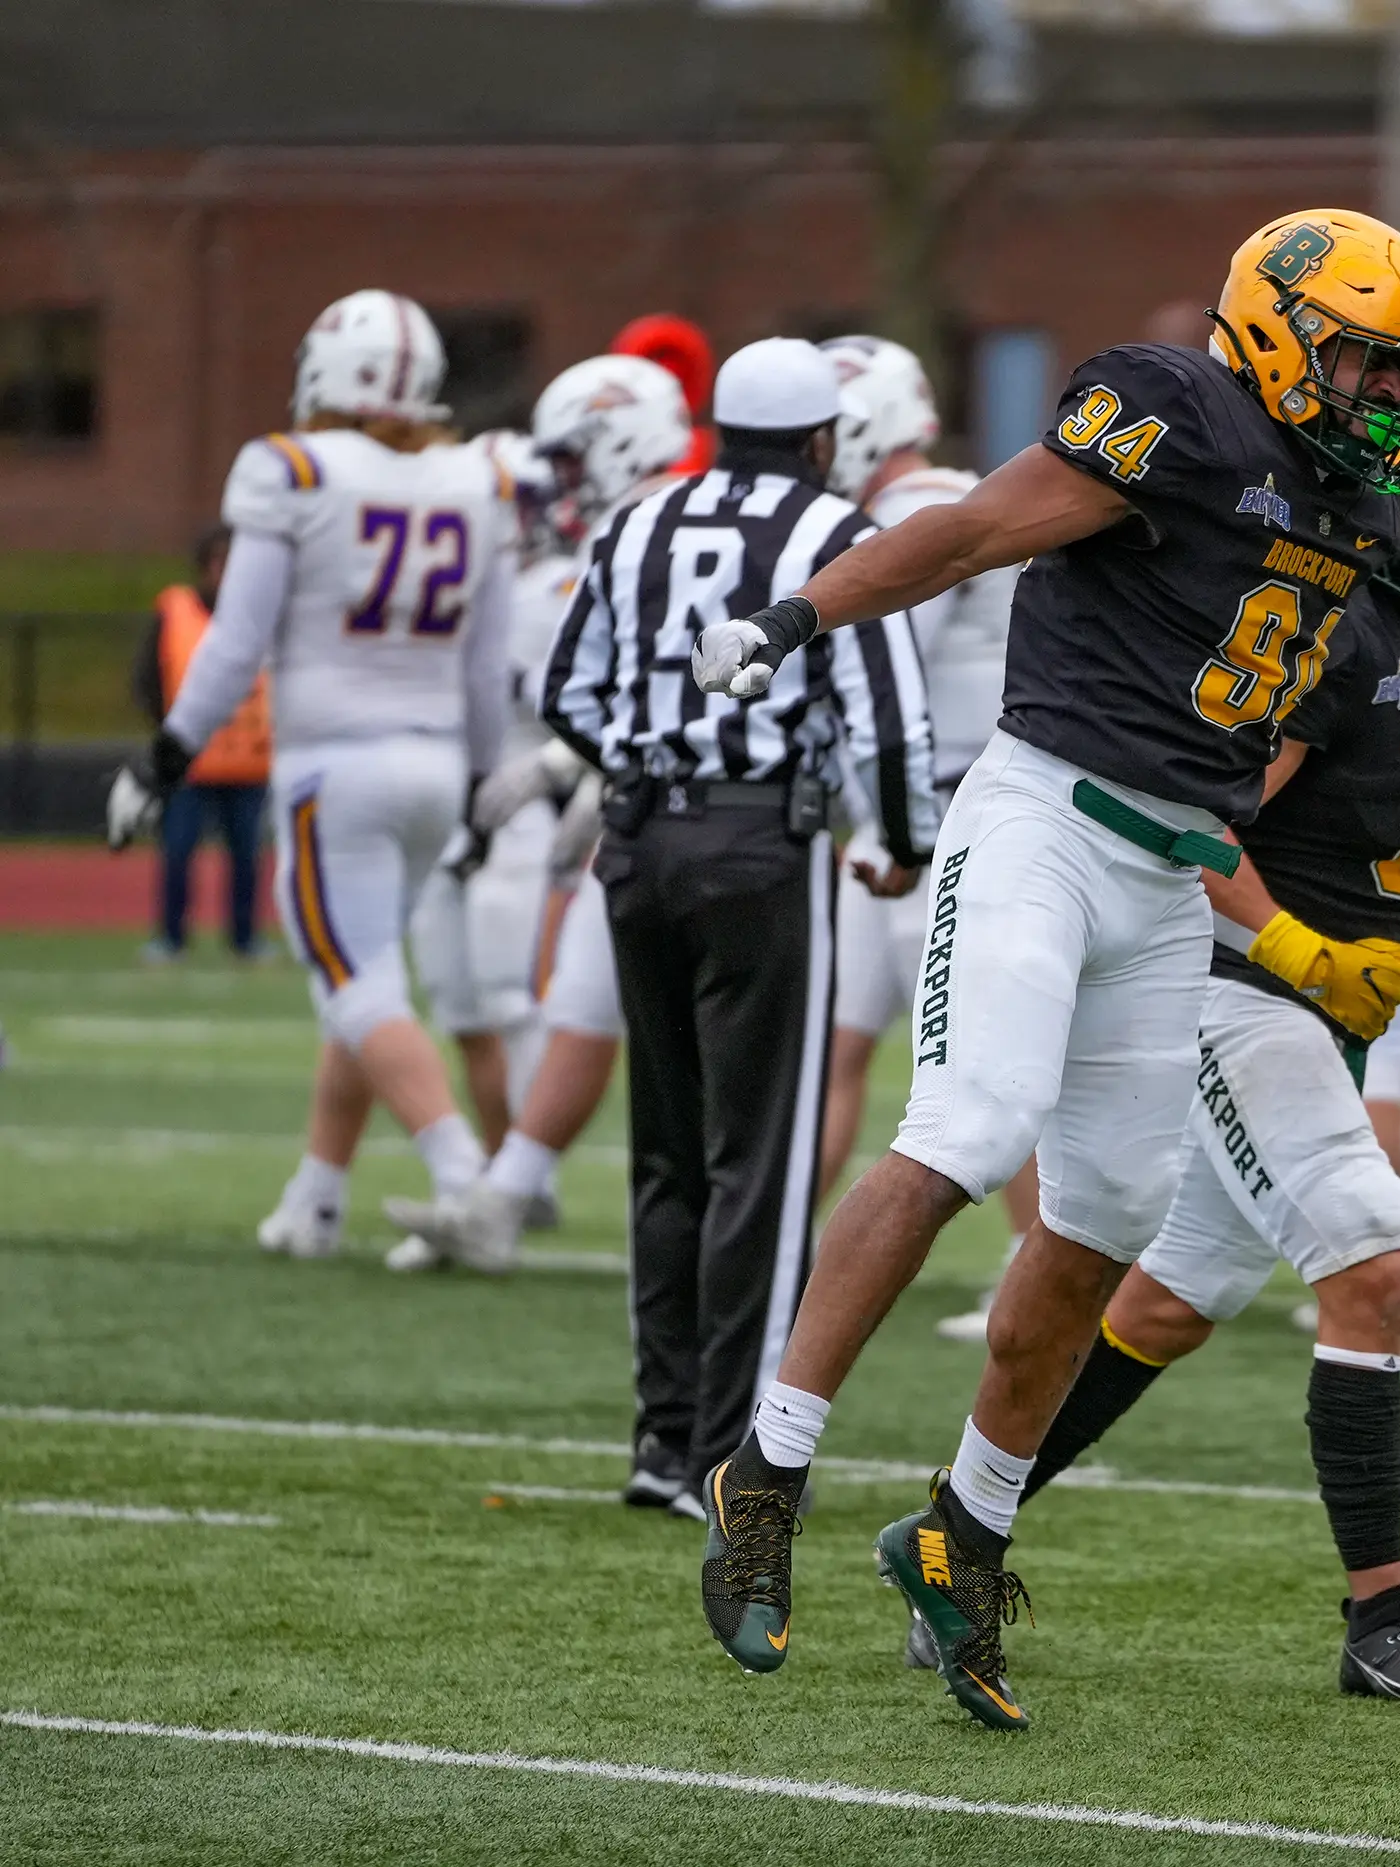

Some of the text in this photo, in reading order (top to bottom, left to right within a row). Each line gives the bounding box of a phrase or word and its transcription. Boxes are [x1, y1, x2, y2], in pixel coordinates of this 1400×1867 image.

[1058, 384, 1170, 484] 94
[342, 504, 471, 637] 72
[654, 527, 746, 660] R
[1262, 538, 1356, 599] BROCKPORT
[918, 846, 970, 1067] BROCKPORT
[1198, 1029, 1274, 1200] OCKPORT
[917, 1527, 953, 1588] NIKE
